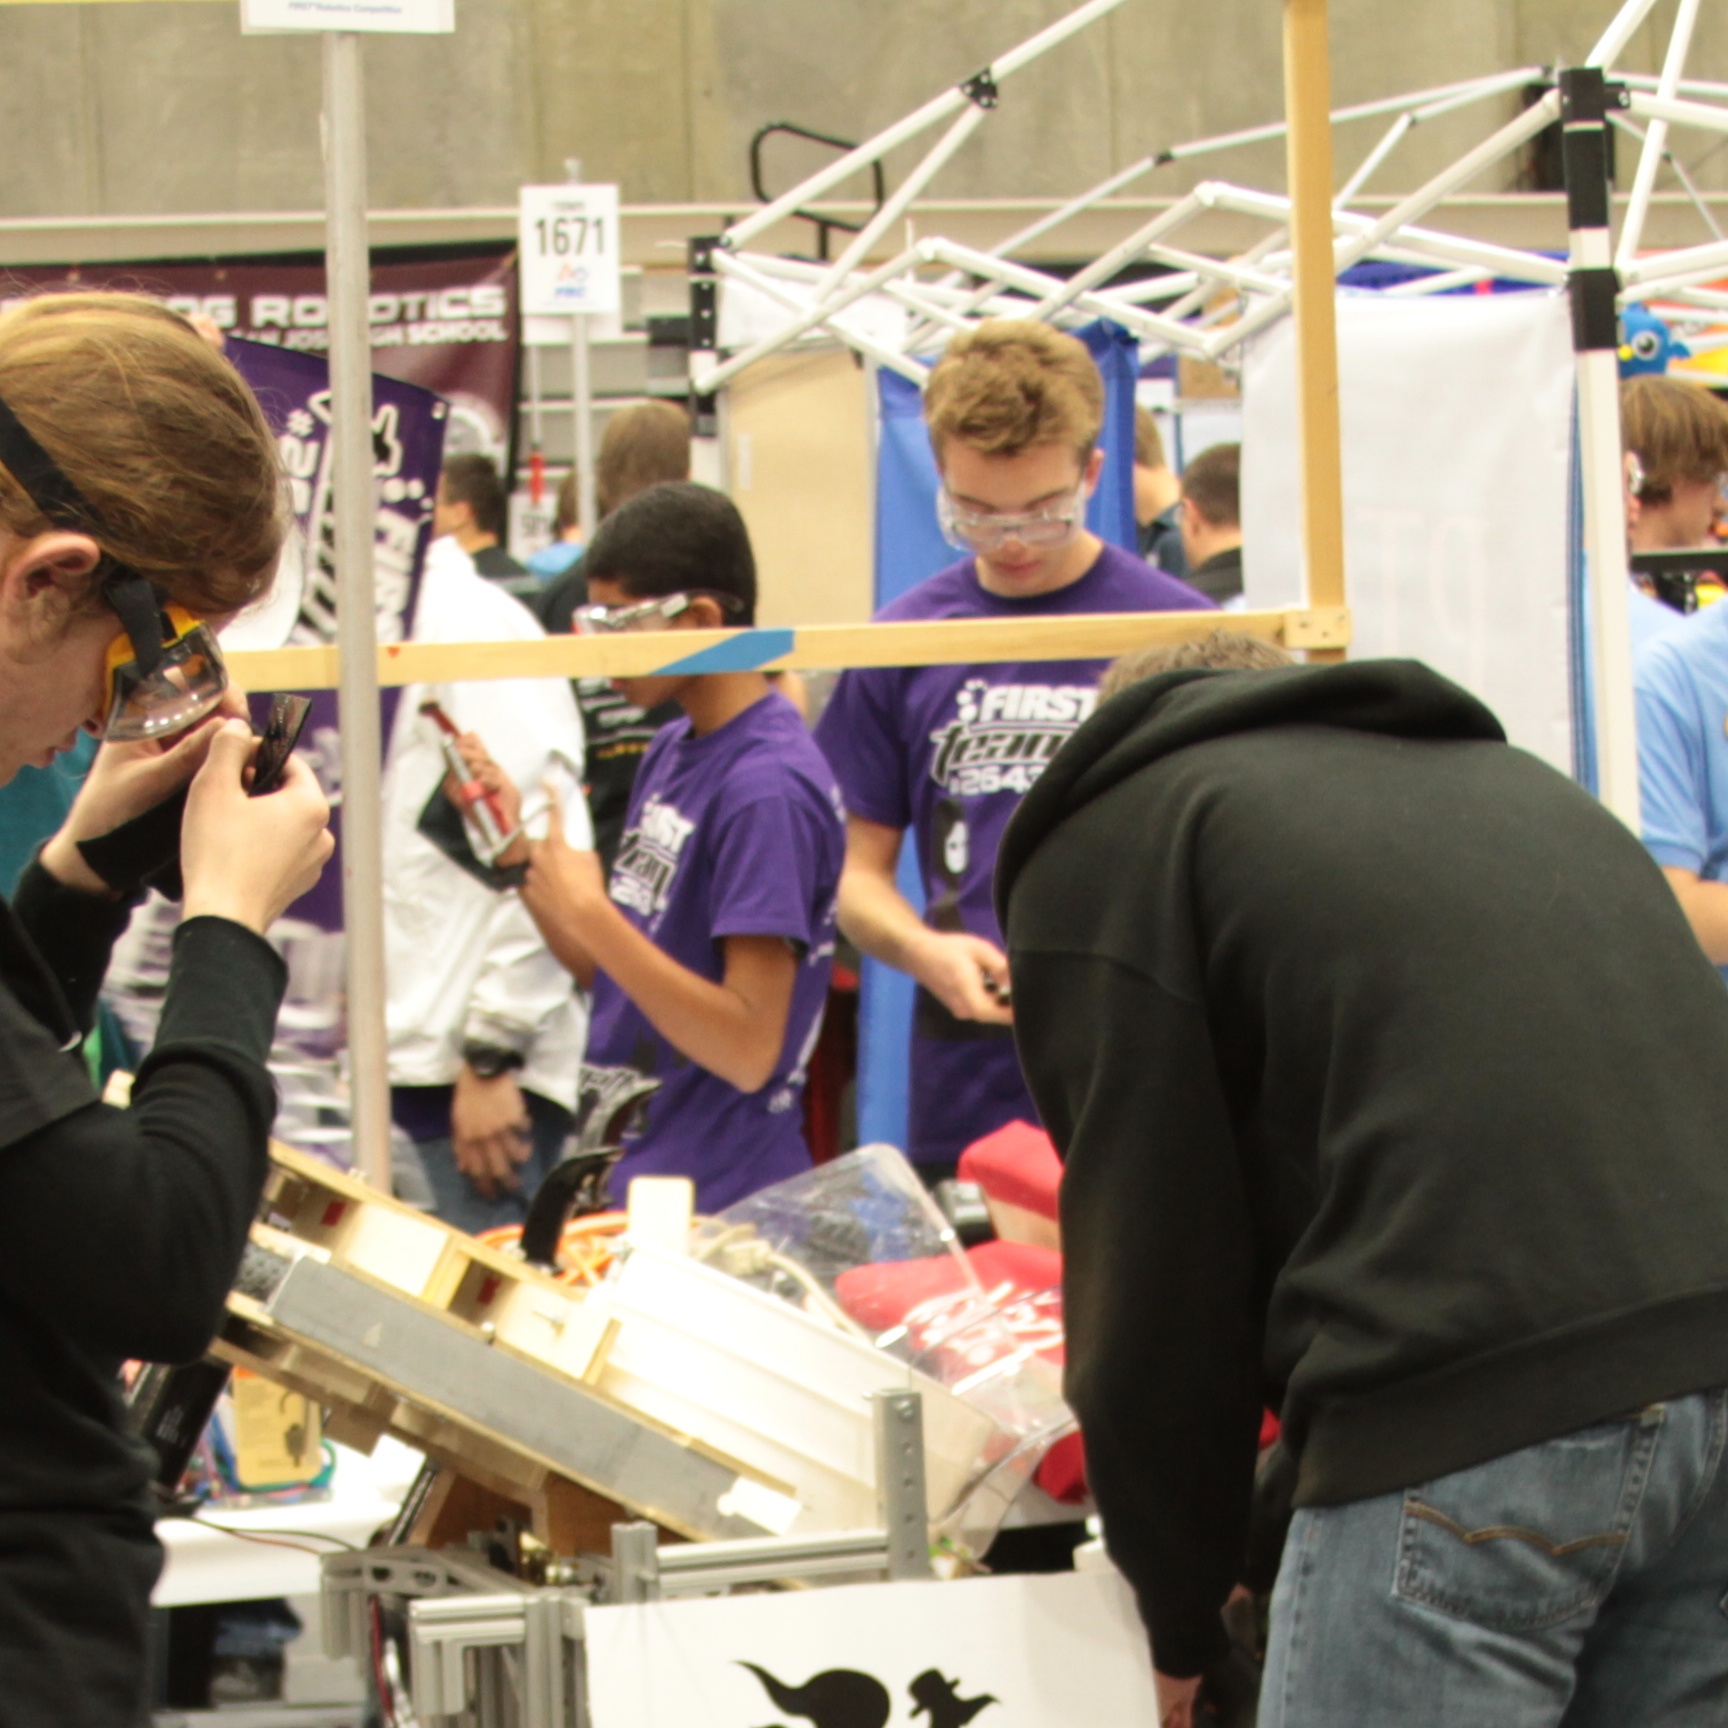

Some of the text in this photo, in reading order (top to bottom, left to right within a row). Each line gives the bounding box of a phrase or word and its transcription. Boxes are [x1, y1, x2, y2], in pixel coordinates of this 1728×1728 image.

[535, 217, 604, 256] 1671
[252, 285, 506, 329] ROOTICS
[407, 320, 509, 345] SCHOOL
[979, 685, 1097, 724] FIRST
